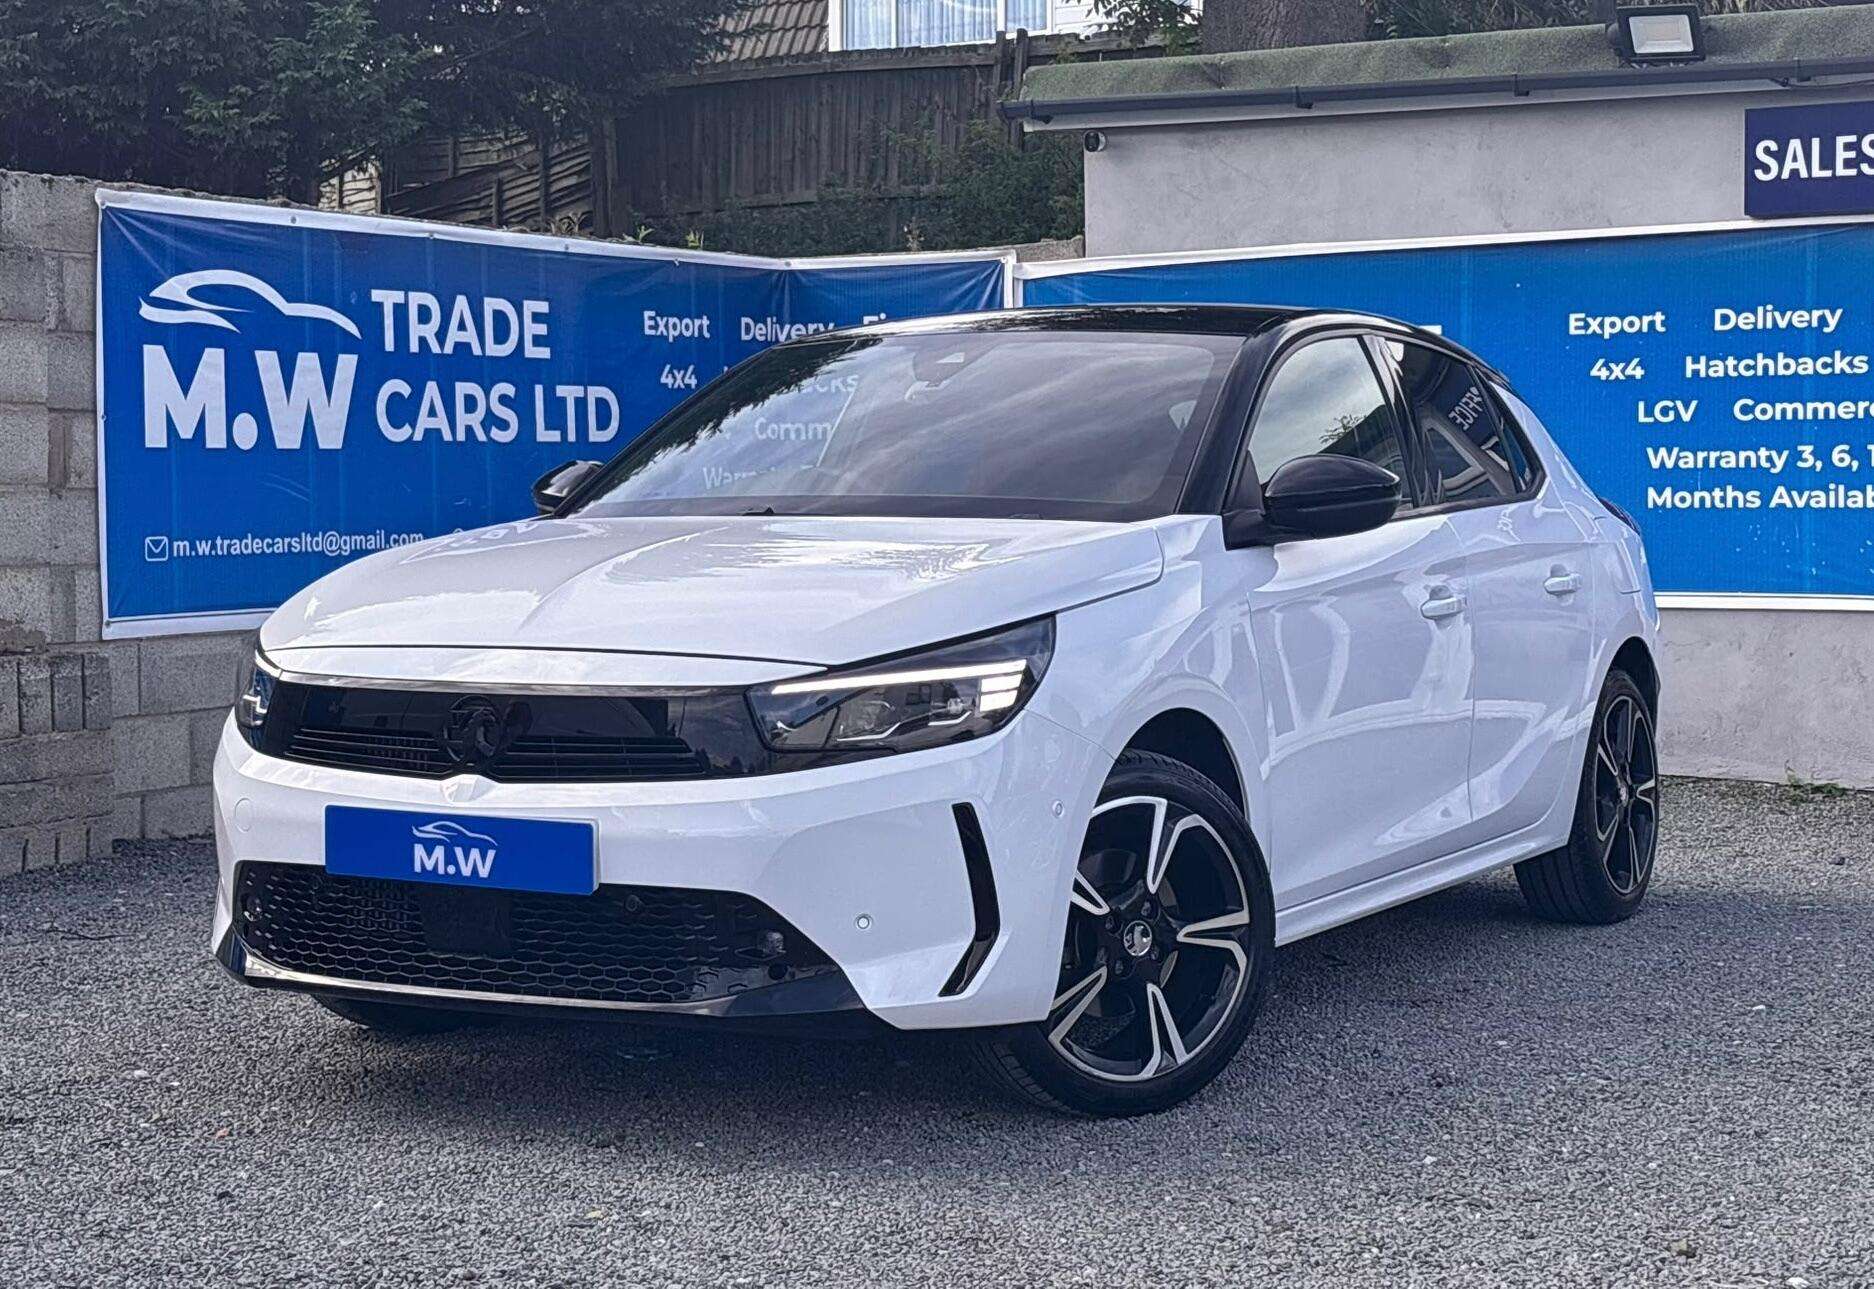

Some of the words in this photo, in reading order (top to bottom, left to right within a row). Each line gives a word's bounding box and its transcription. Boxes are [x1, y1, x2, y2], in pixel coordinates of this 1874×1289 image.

[370, 288, 551, 359] TRADE
[643, 310, 711, 342] Export
[1568, 311, 1666, 339] Export
[1714, 305, 1843, 333] Delivery
[660, 364, 698, 389] 4x4
[1589, 358, 1645, 381] 4x4
[1685, 350, 1869, 378] Hatchbacks
[142, 344, 359, 450] M.W
[376, 379, 519, 443] CARS
[535, 384, 620, 443] LTD
[1637, 400, 1698, 423] LGV
[1733, 398, 1874, 421] Commer
[1646, 446, 1790, 474] Warranty
[1796, 445, 1823, 472] 3,
[1831, 444, 1859, 472] 6,
[1647, 485, 1762, 509] Months
[173, 529, 424, 557] m.w.tradecarsltd@gmail.com
[414, 843, 496, 878] M.W
